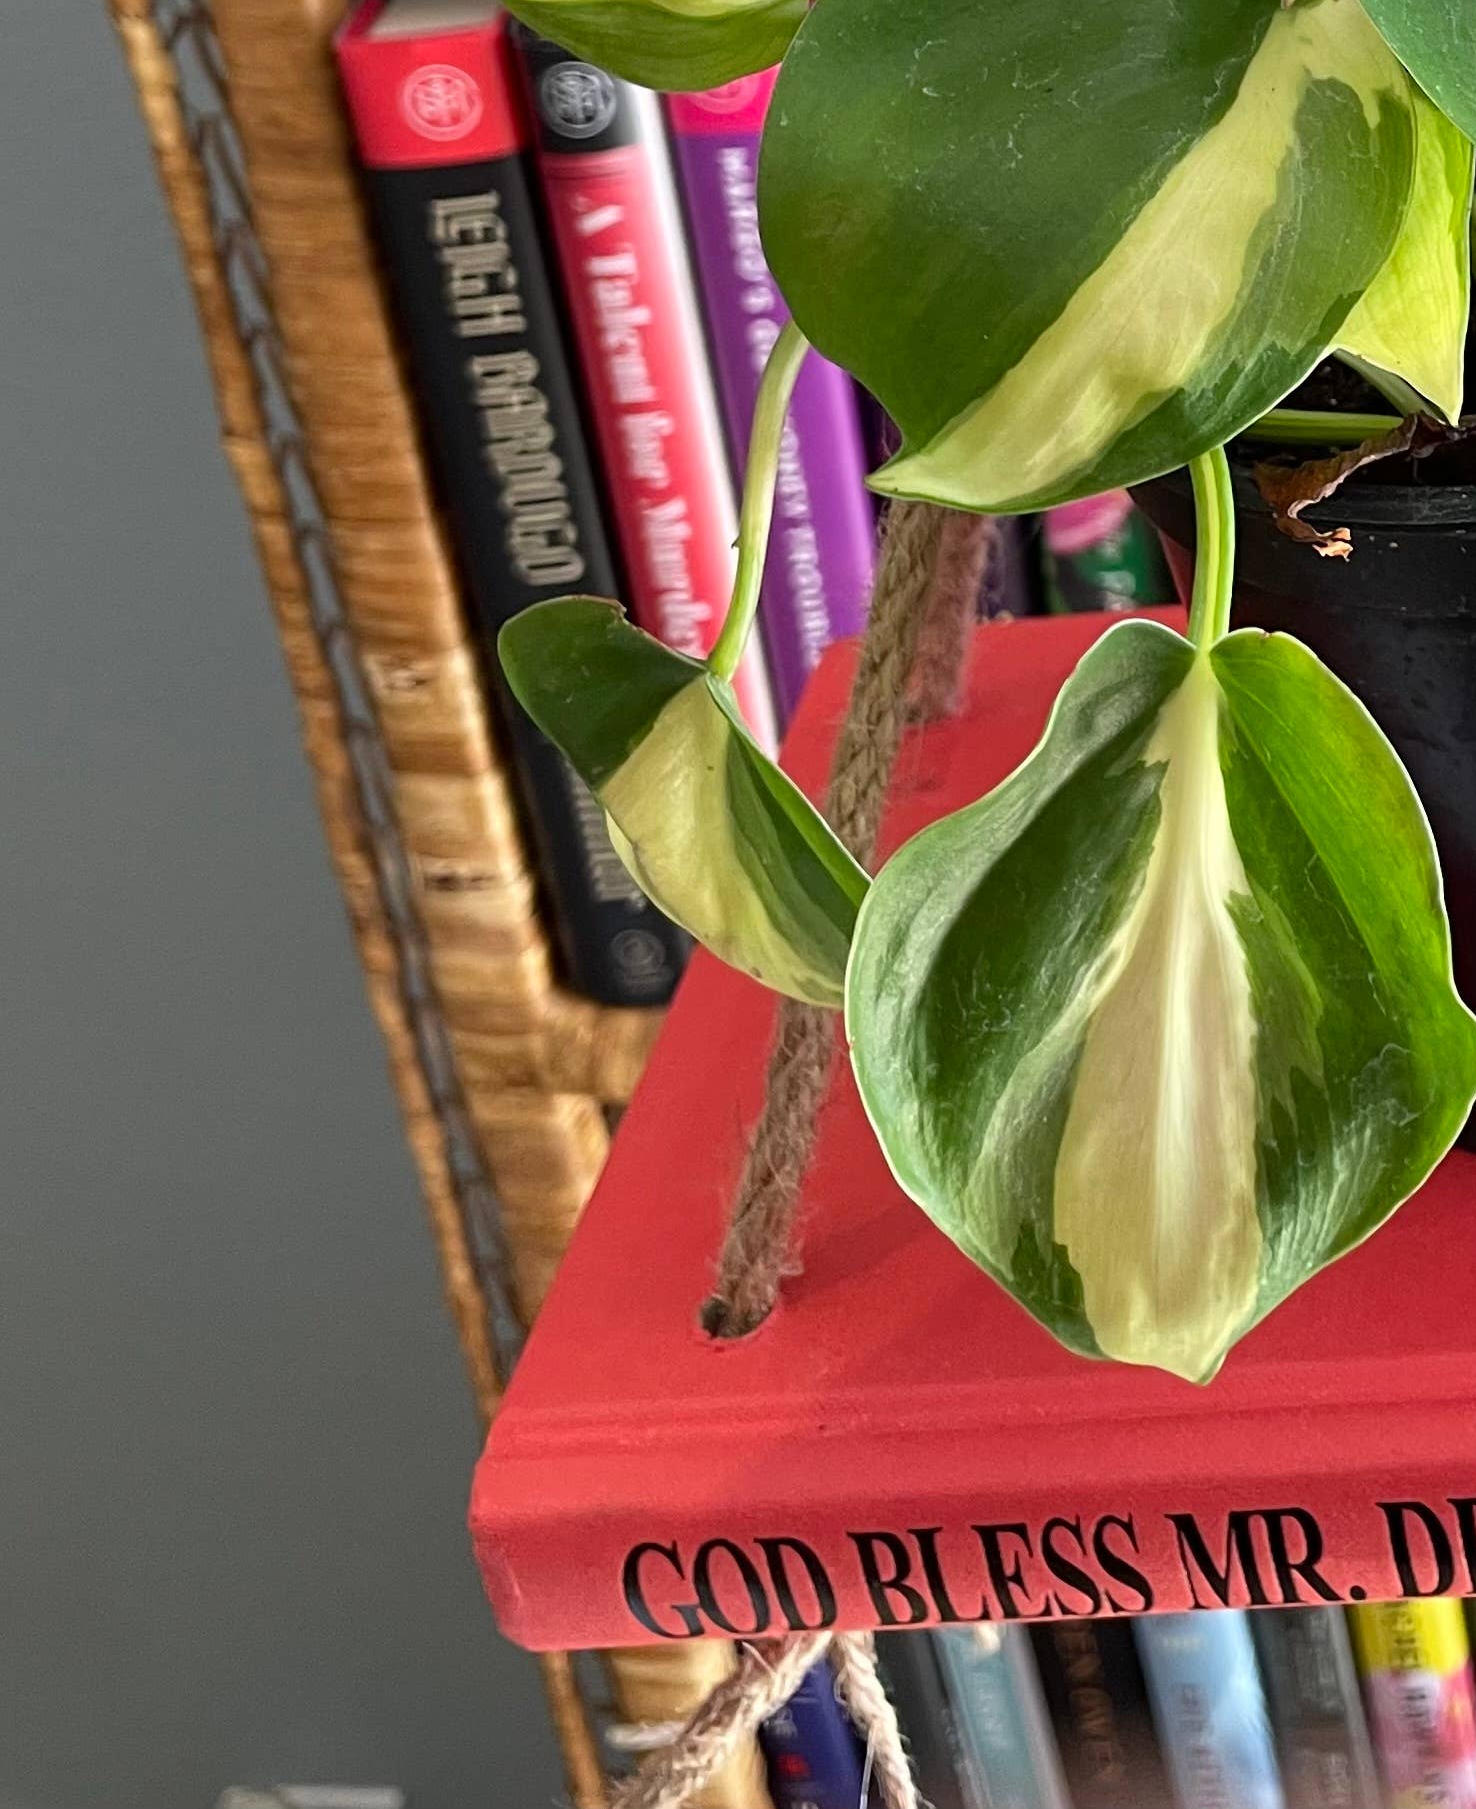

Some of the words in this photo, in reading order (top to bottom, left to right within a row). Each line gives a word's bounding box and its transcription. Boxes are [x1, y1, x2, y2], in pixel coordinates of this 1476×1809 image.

[428, 191, 526, 339] LEIGH
[586, 248, 662, 404] Talent
[622, 1534, 837, 1639] GOD
[846, 1511, 1154, 1627] BLESS
[1166, 1504, 1369, 1612] MR.
